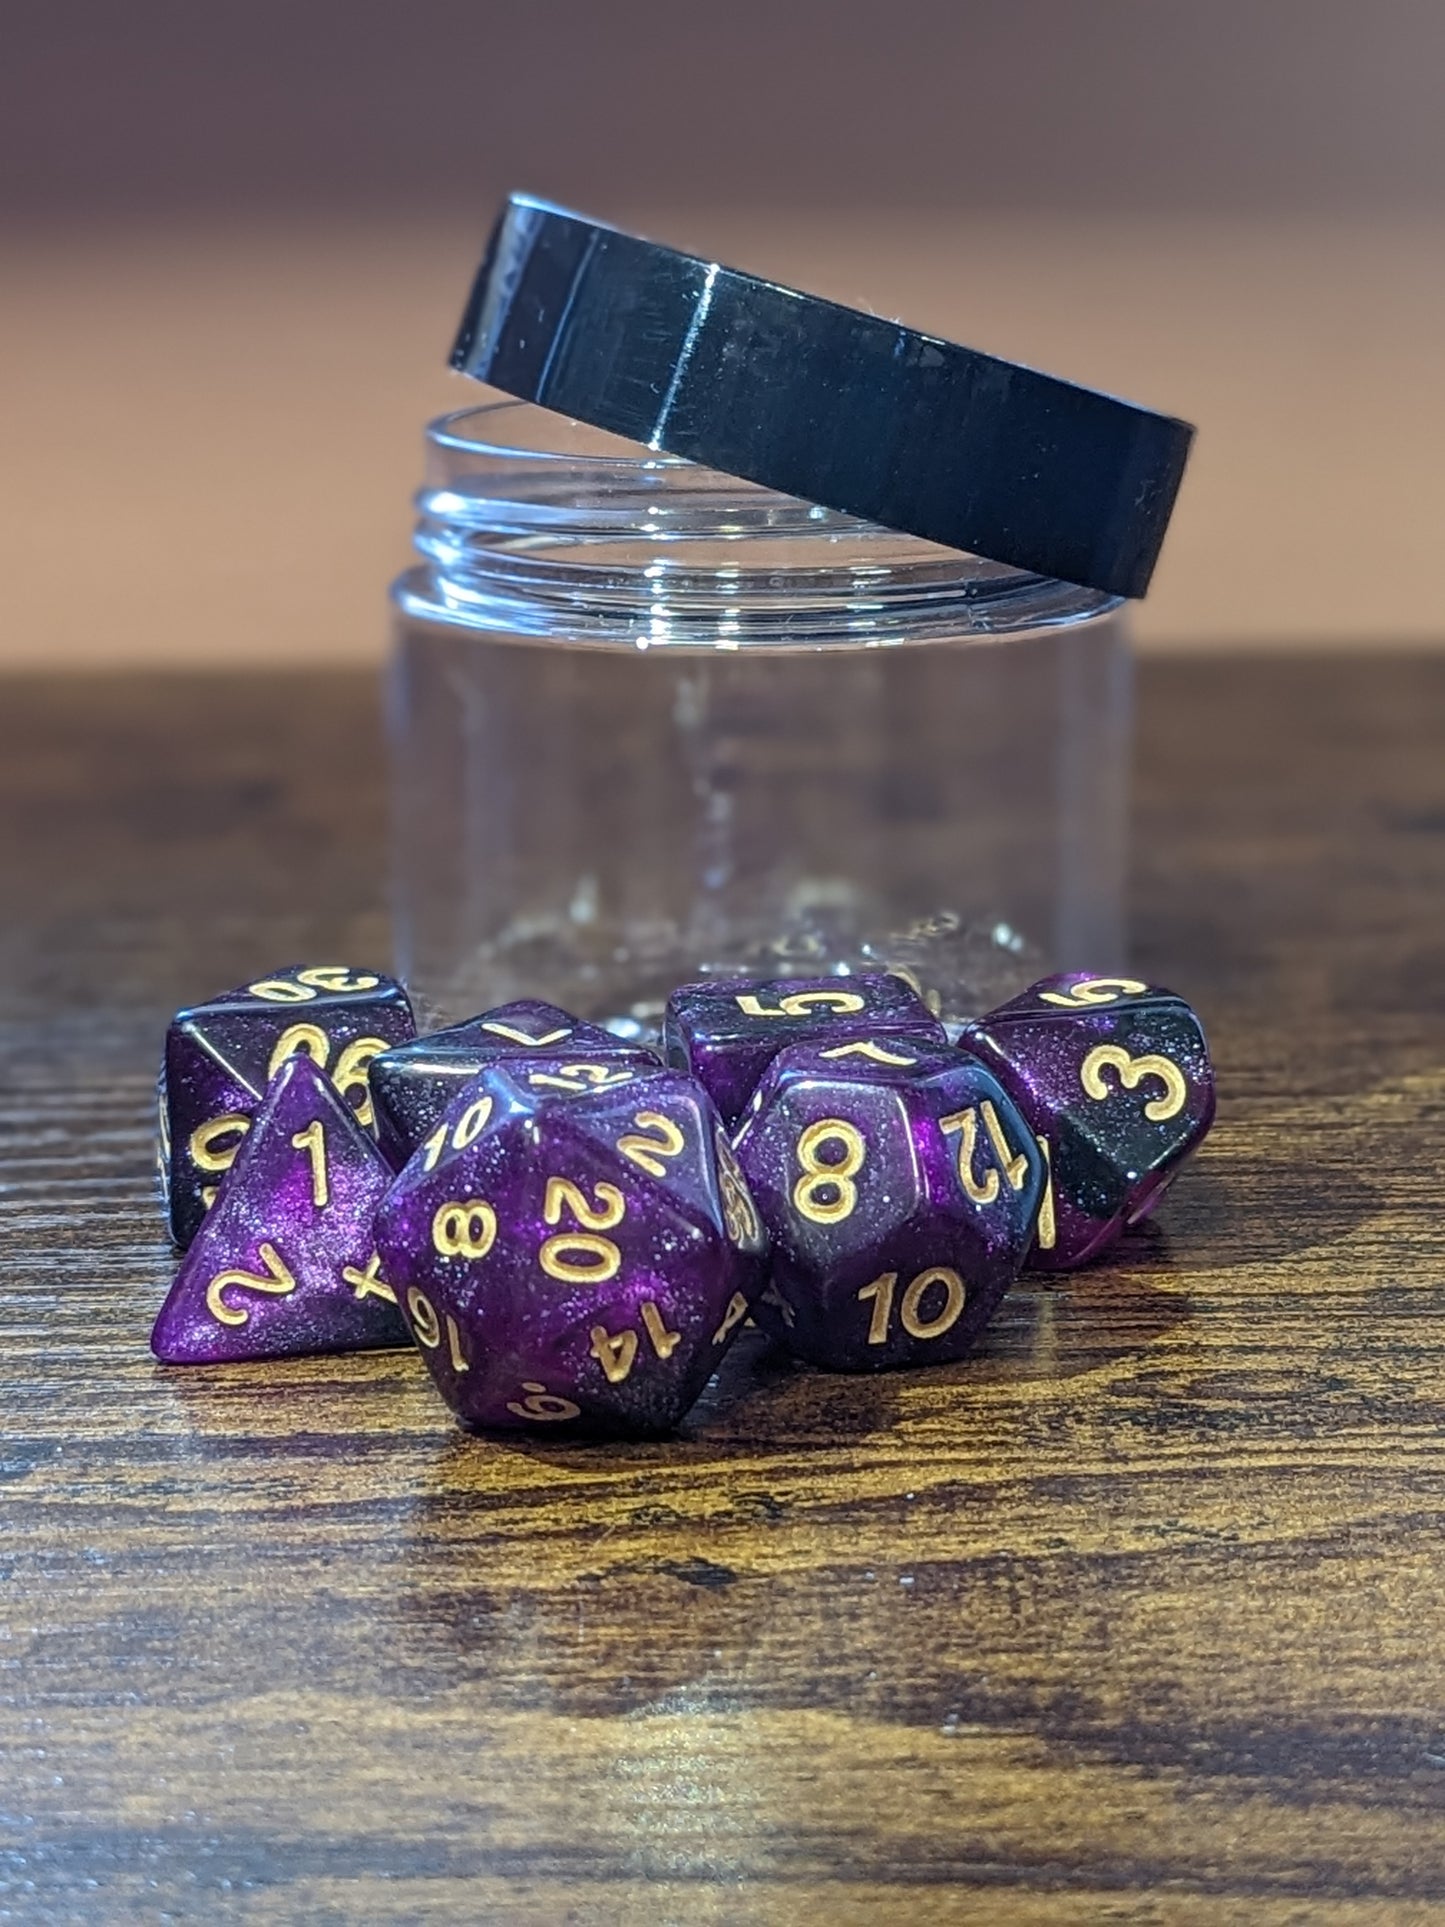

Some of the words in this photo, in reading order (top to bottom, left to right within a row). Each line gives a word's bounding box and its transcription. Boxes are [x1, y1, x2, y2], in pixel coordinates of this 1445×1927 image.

[249, 966, 379, 1002] 30
[1040, 978, 1146, 1007] 5
[1080, 1044, 1186, 1121] 3
[291, 1120, 328, 1207] 1
[422, 1096, 493, 1172] 10
[617, 1111, 685, 1178] 2
[793, 1118, 866, 1224] 8
[938, 1100, 1028, 1204] 12
[431, 1200, 498, 1259] 8
[538, 1176, 626, 1284] 20
[206, 1242, 297, 1326] 2
[857, 1267, 967, 1346] 10
[589, 1301, 682, 1384] 14
